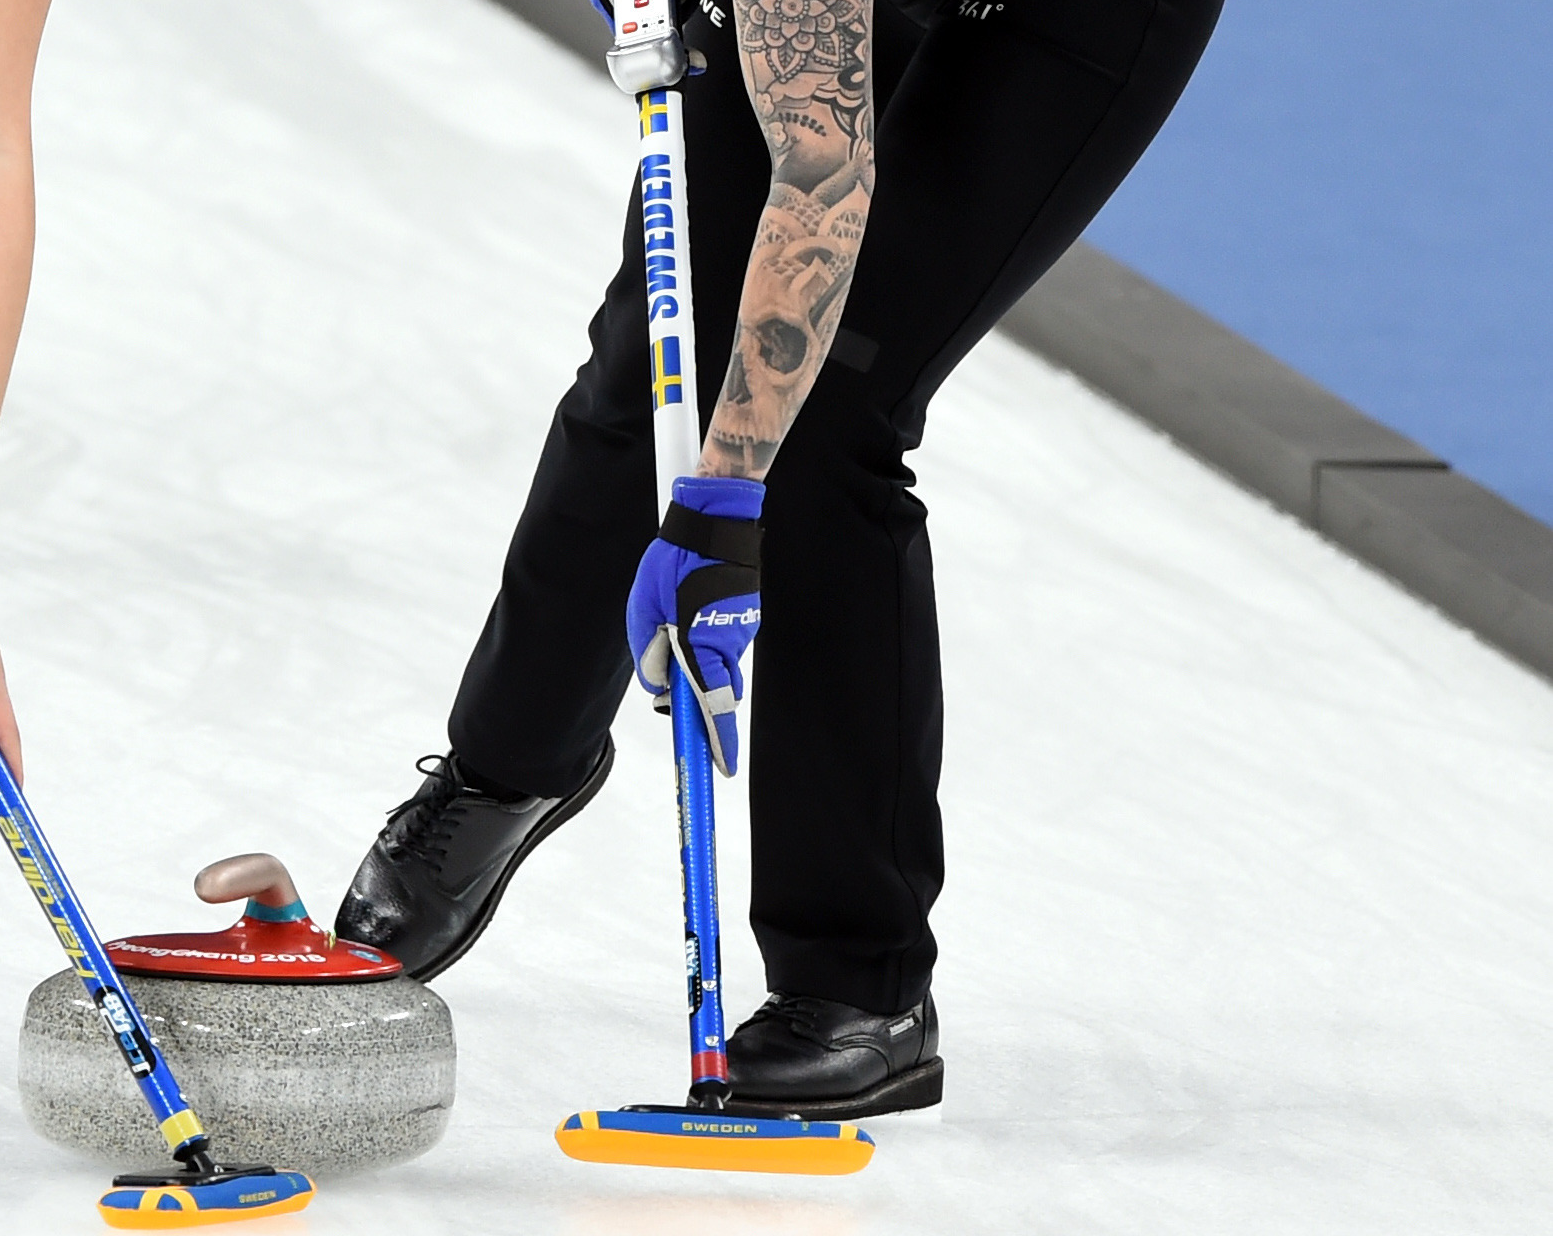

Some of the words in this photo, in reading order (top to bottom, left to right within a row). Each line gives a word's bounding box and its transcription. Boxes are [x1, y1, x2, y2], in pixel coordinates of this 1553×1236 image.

[640, 153, 679, 323] SWEDEN
[106, 940, 256, 963] yeongChang
[681, 1121, 758, 1134] SWEDEN
[238, 1189, 278, 1204] SWEDEN
